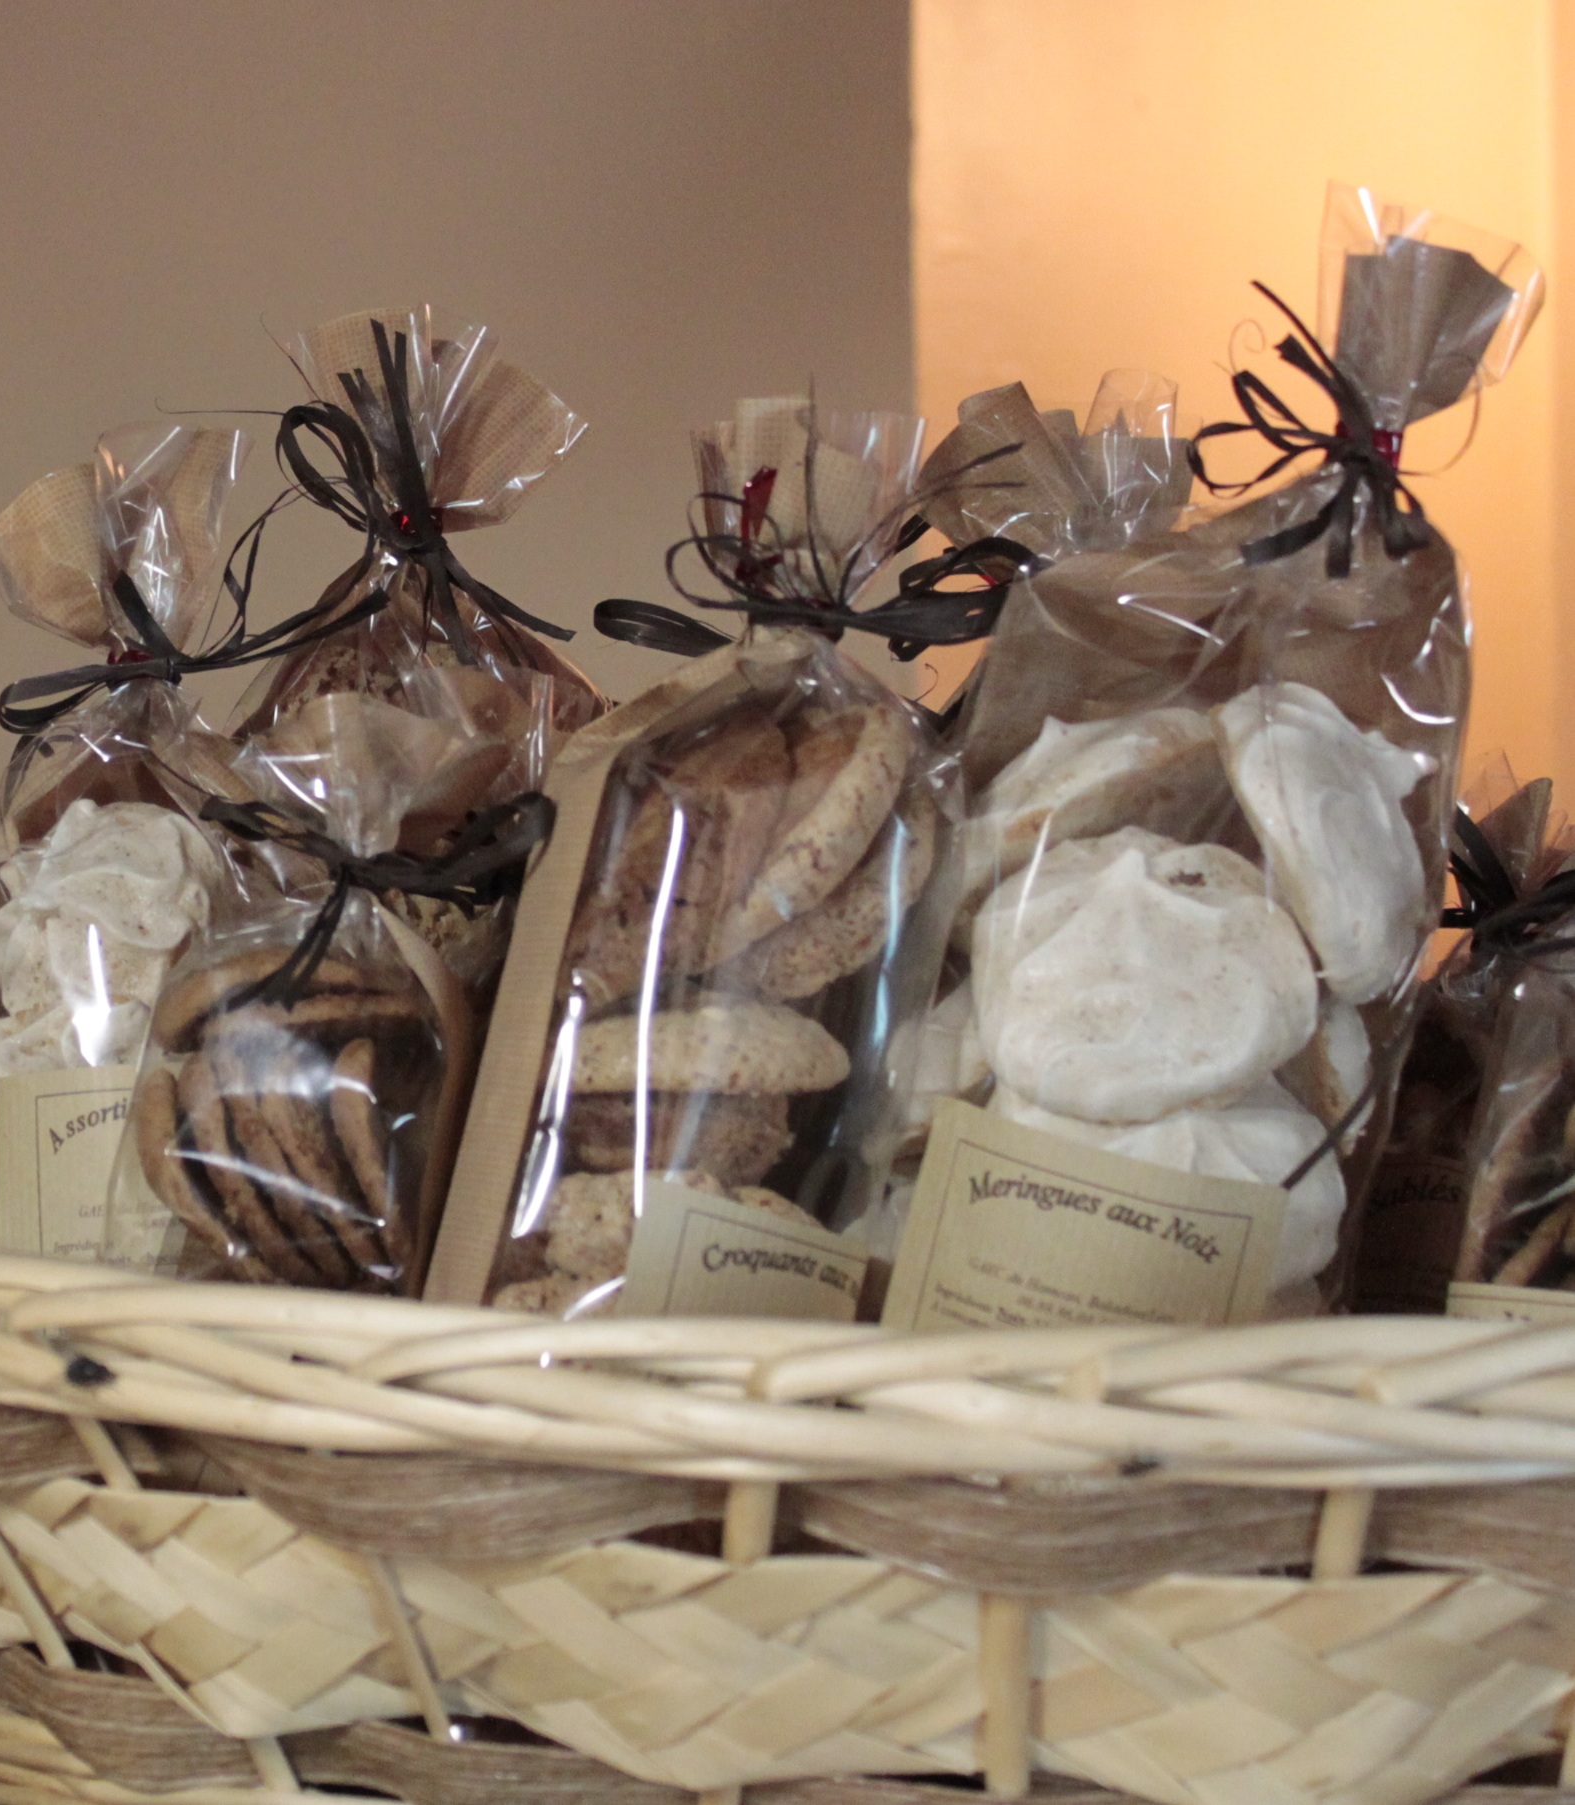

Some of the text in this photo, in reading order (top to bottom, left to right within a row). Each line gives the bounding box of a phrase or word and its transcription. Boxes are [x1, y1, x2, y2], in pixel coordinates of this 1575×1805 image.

[968, 1171, 1221, 1263] Meringues aux Noix
[702, 1243, 817, 1278] Croquants
